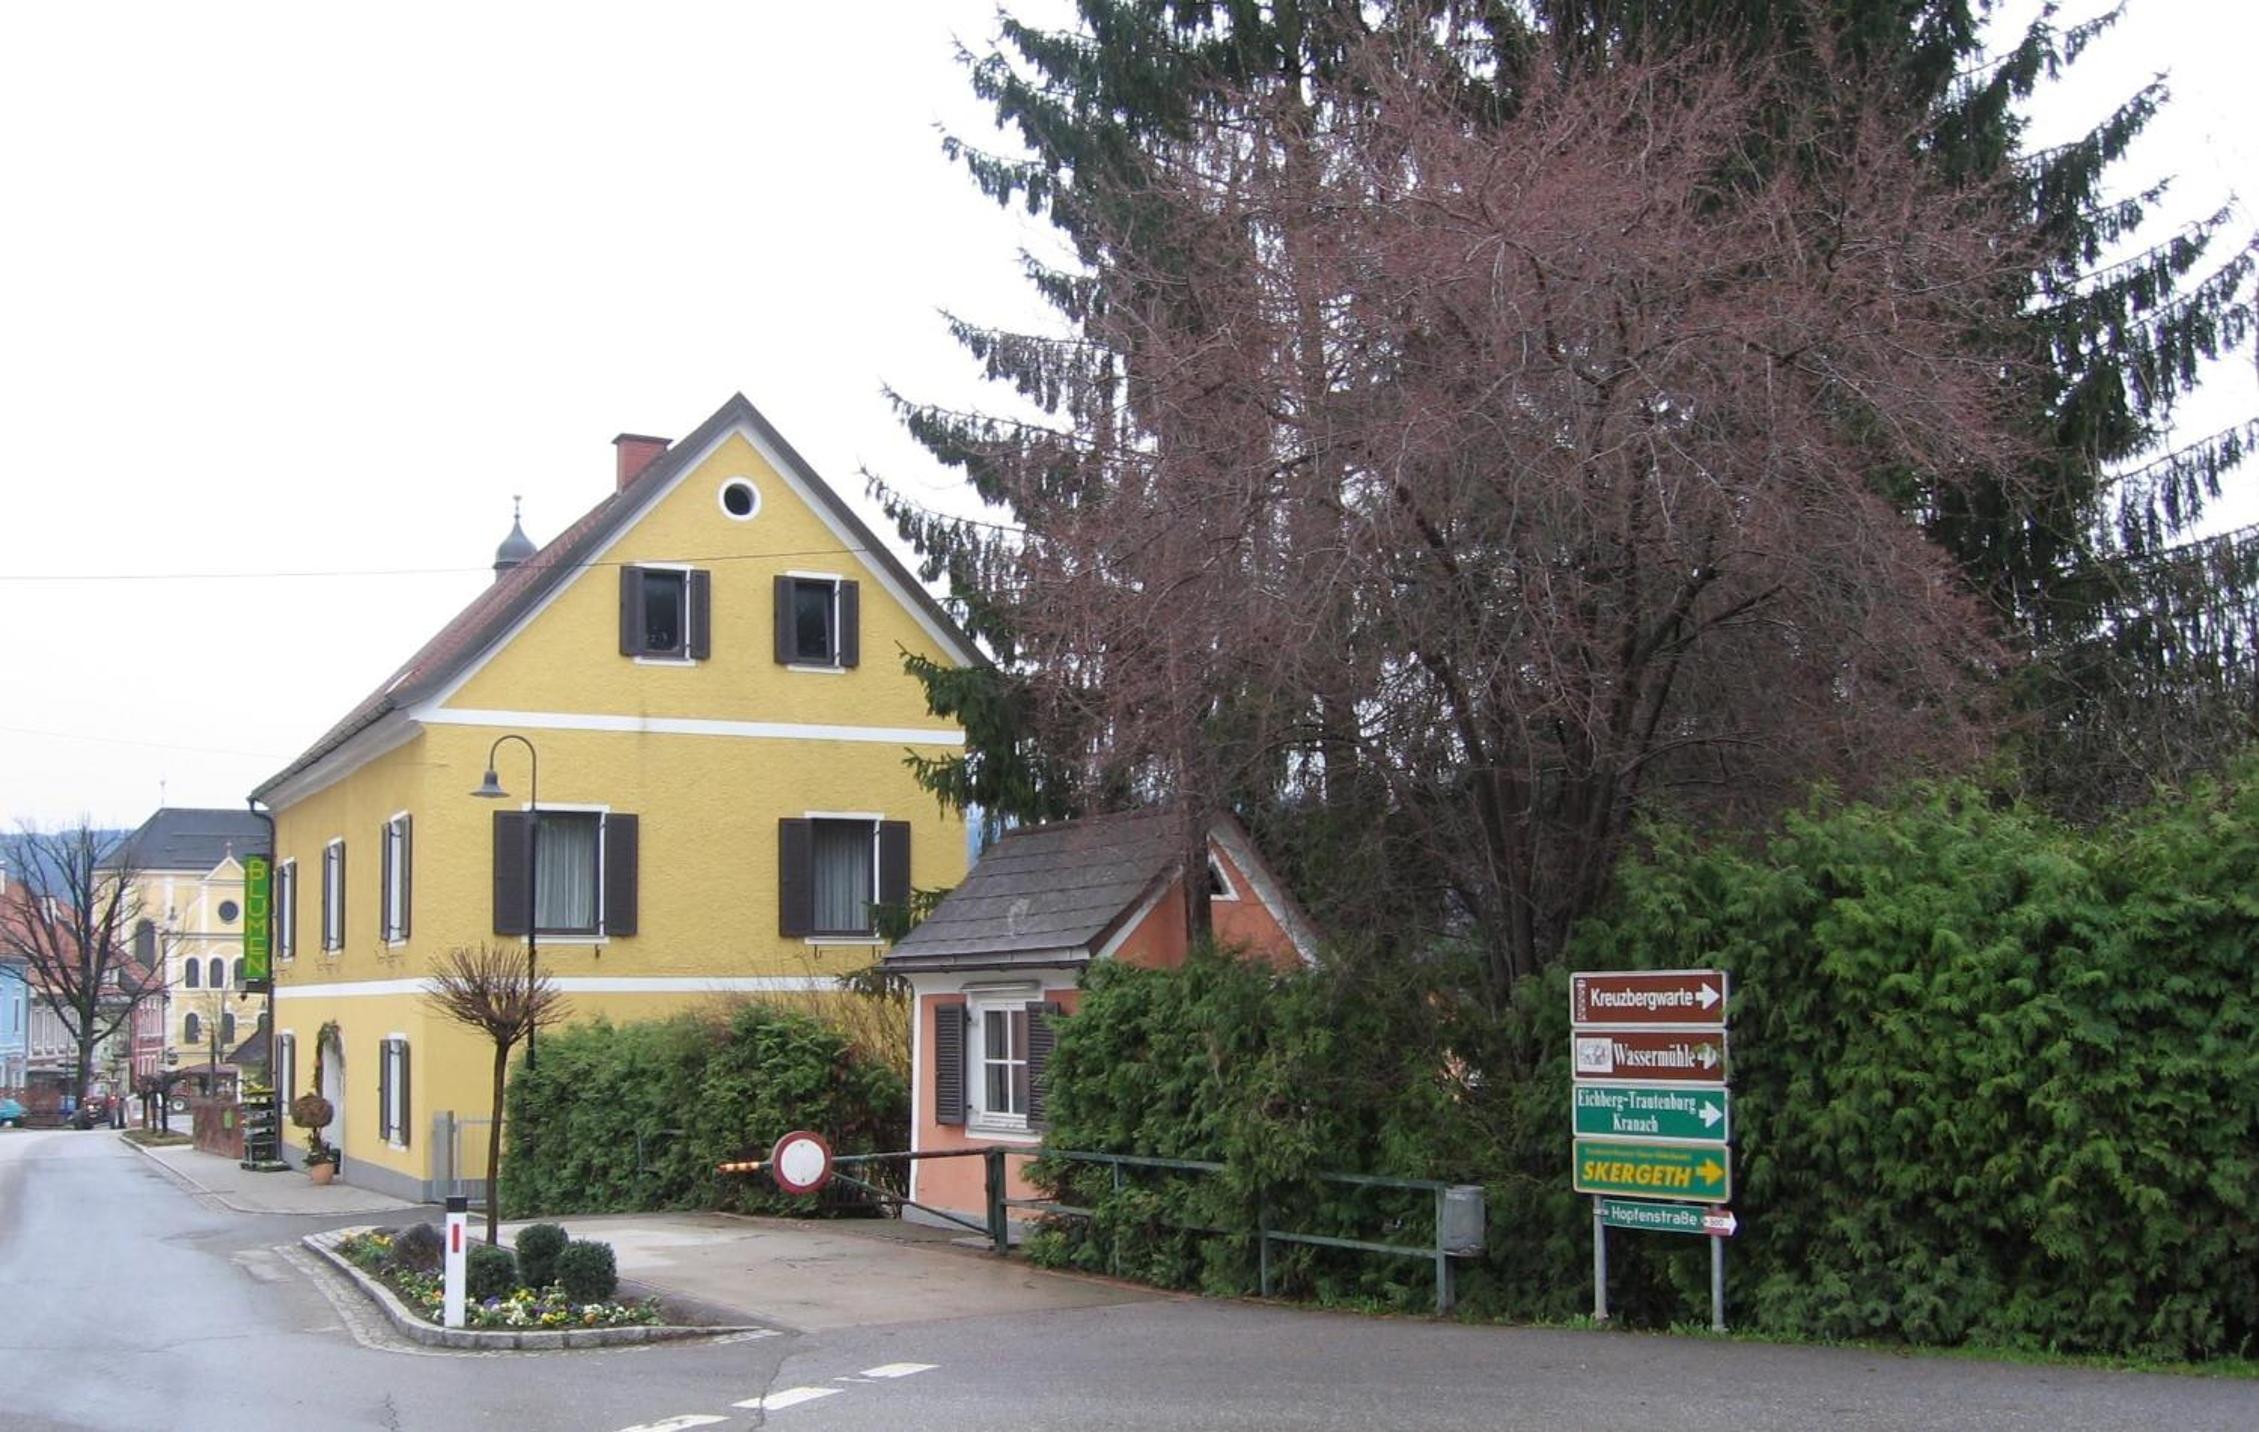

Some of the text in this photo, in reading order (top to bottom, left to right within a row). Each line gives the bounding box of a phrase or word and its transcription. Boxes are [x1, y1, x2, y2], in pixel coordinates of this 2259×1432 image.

[247, 859, 267, 976] BLUMEN
[1591, 987, 1694, 1011] Kreuzbergwarte
[1613, 1043, 1696, 1068] Wassermühle
[1578, 1089, 1696, 1115] Eichberg-Trautenburg
[1613, 1113, 1659, 1133] Kranach
[1583, 1161, 1692, 1188] SKERGETH
[1611, 1206, 1697, 1226] Hopfenstraße
